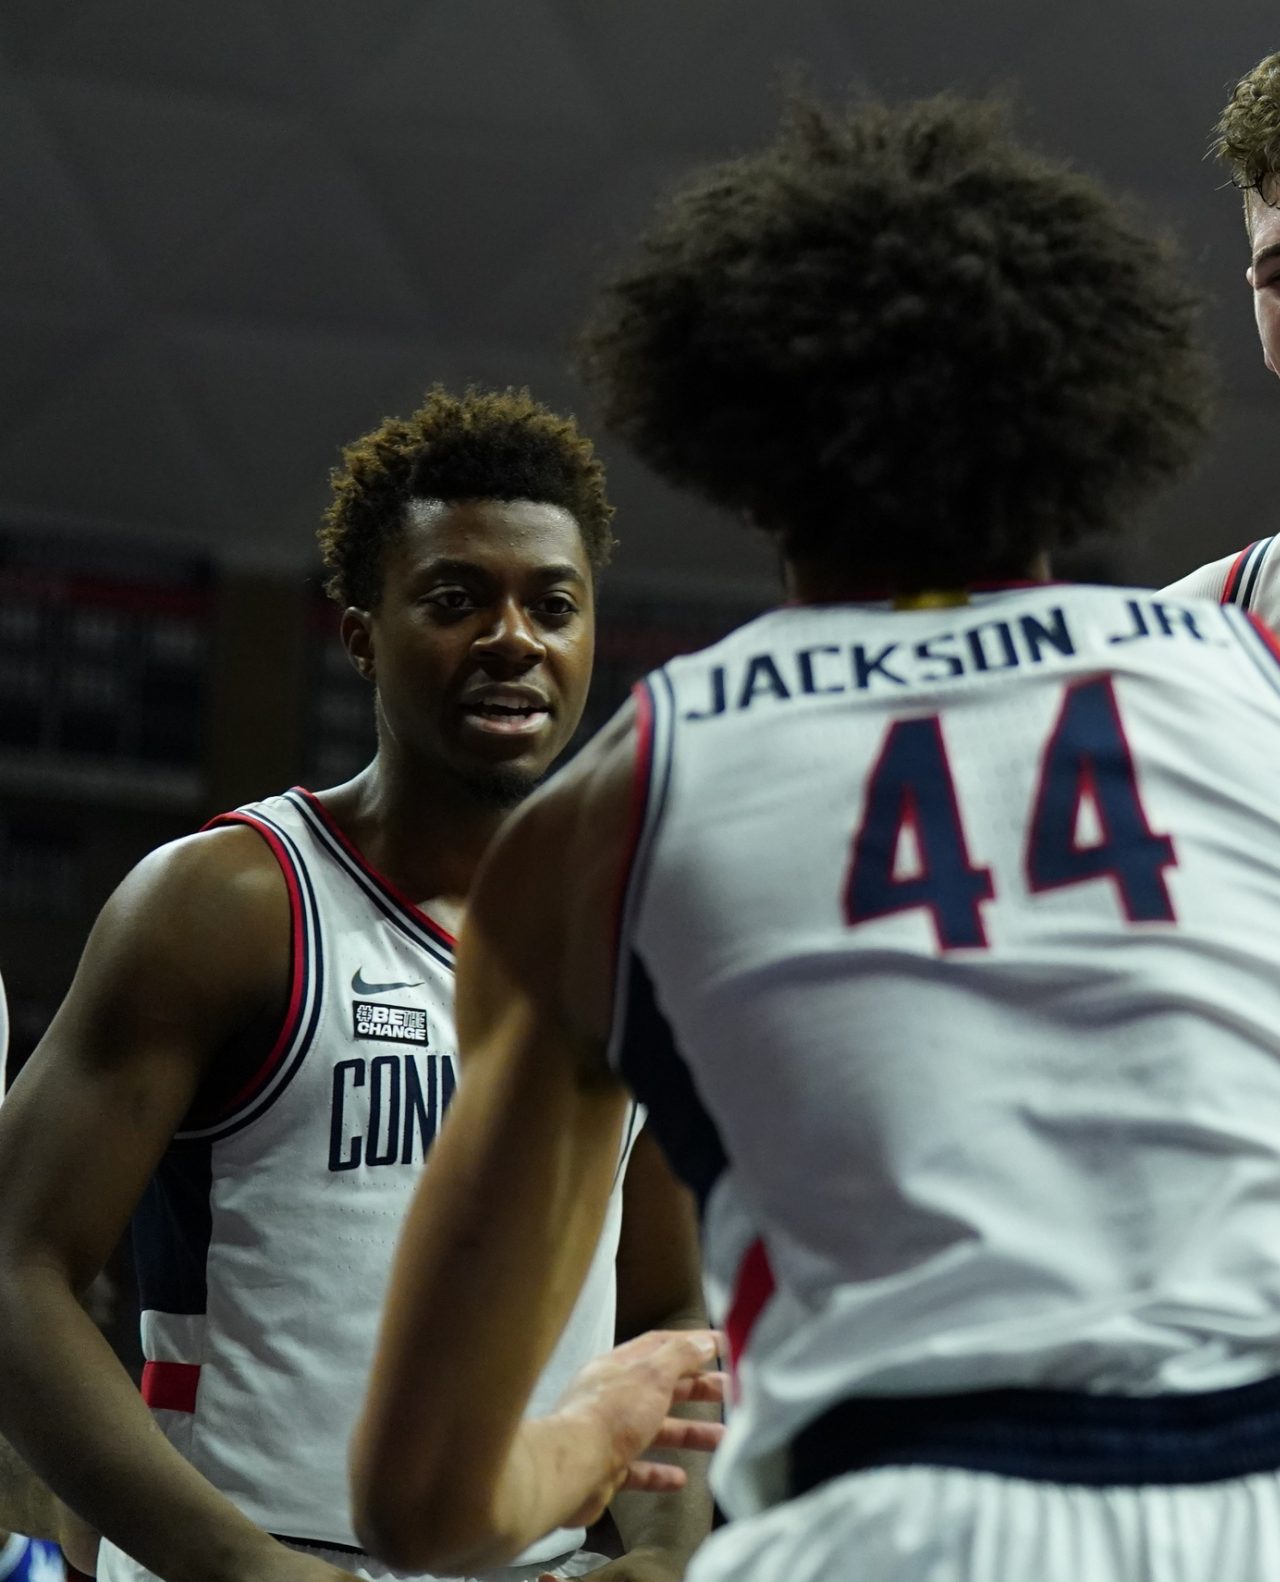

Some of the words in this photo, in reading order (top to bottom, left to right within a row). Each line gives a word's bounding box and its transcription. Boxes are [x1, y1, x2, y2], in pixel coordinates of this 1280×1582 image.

[685, 606, 1076, 721] JACKSON
[843, 672, 1178, 954] 44
[358, 1023, 427, 1041] CHANGE
